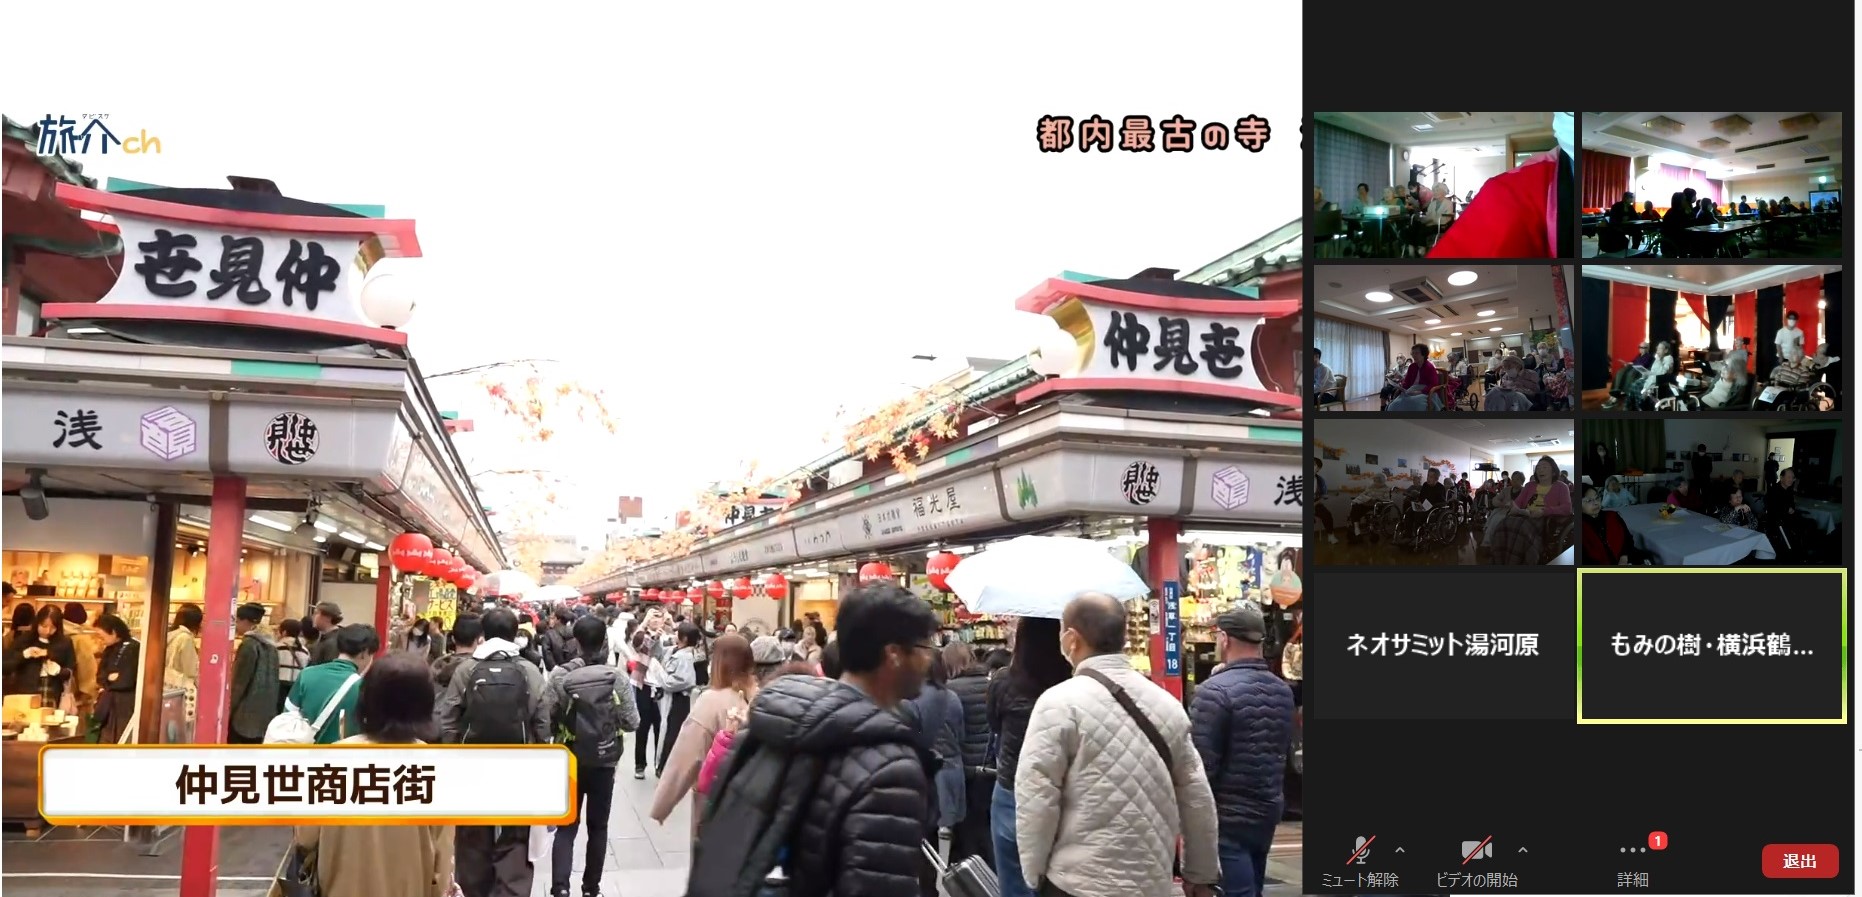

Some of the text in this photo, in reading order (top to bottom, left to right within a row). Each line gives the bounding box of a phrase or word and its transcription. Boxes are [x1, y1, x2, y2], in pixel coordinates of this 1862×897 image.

[1104, 310, 1245, 379] 仲見世
[53, 409, 103, 450] 浅
[912, 486, 961, 519] 福光屋
[1347, 633, 1539, 657] ネオサミット湯河原
[1166, 658, 1179, 670] 18
[1783, 853, 1817, 869] 退出
[1322, 872, 1399, 888] ミュート解除
[1436, 872, 1518, 888] ビデオの開始
[1617, 872, 1649, 888] 詳細
